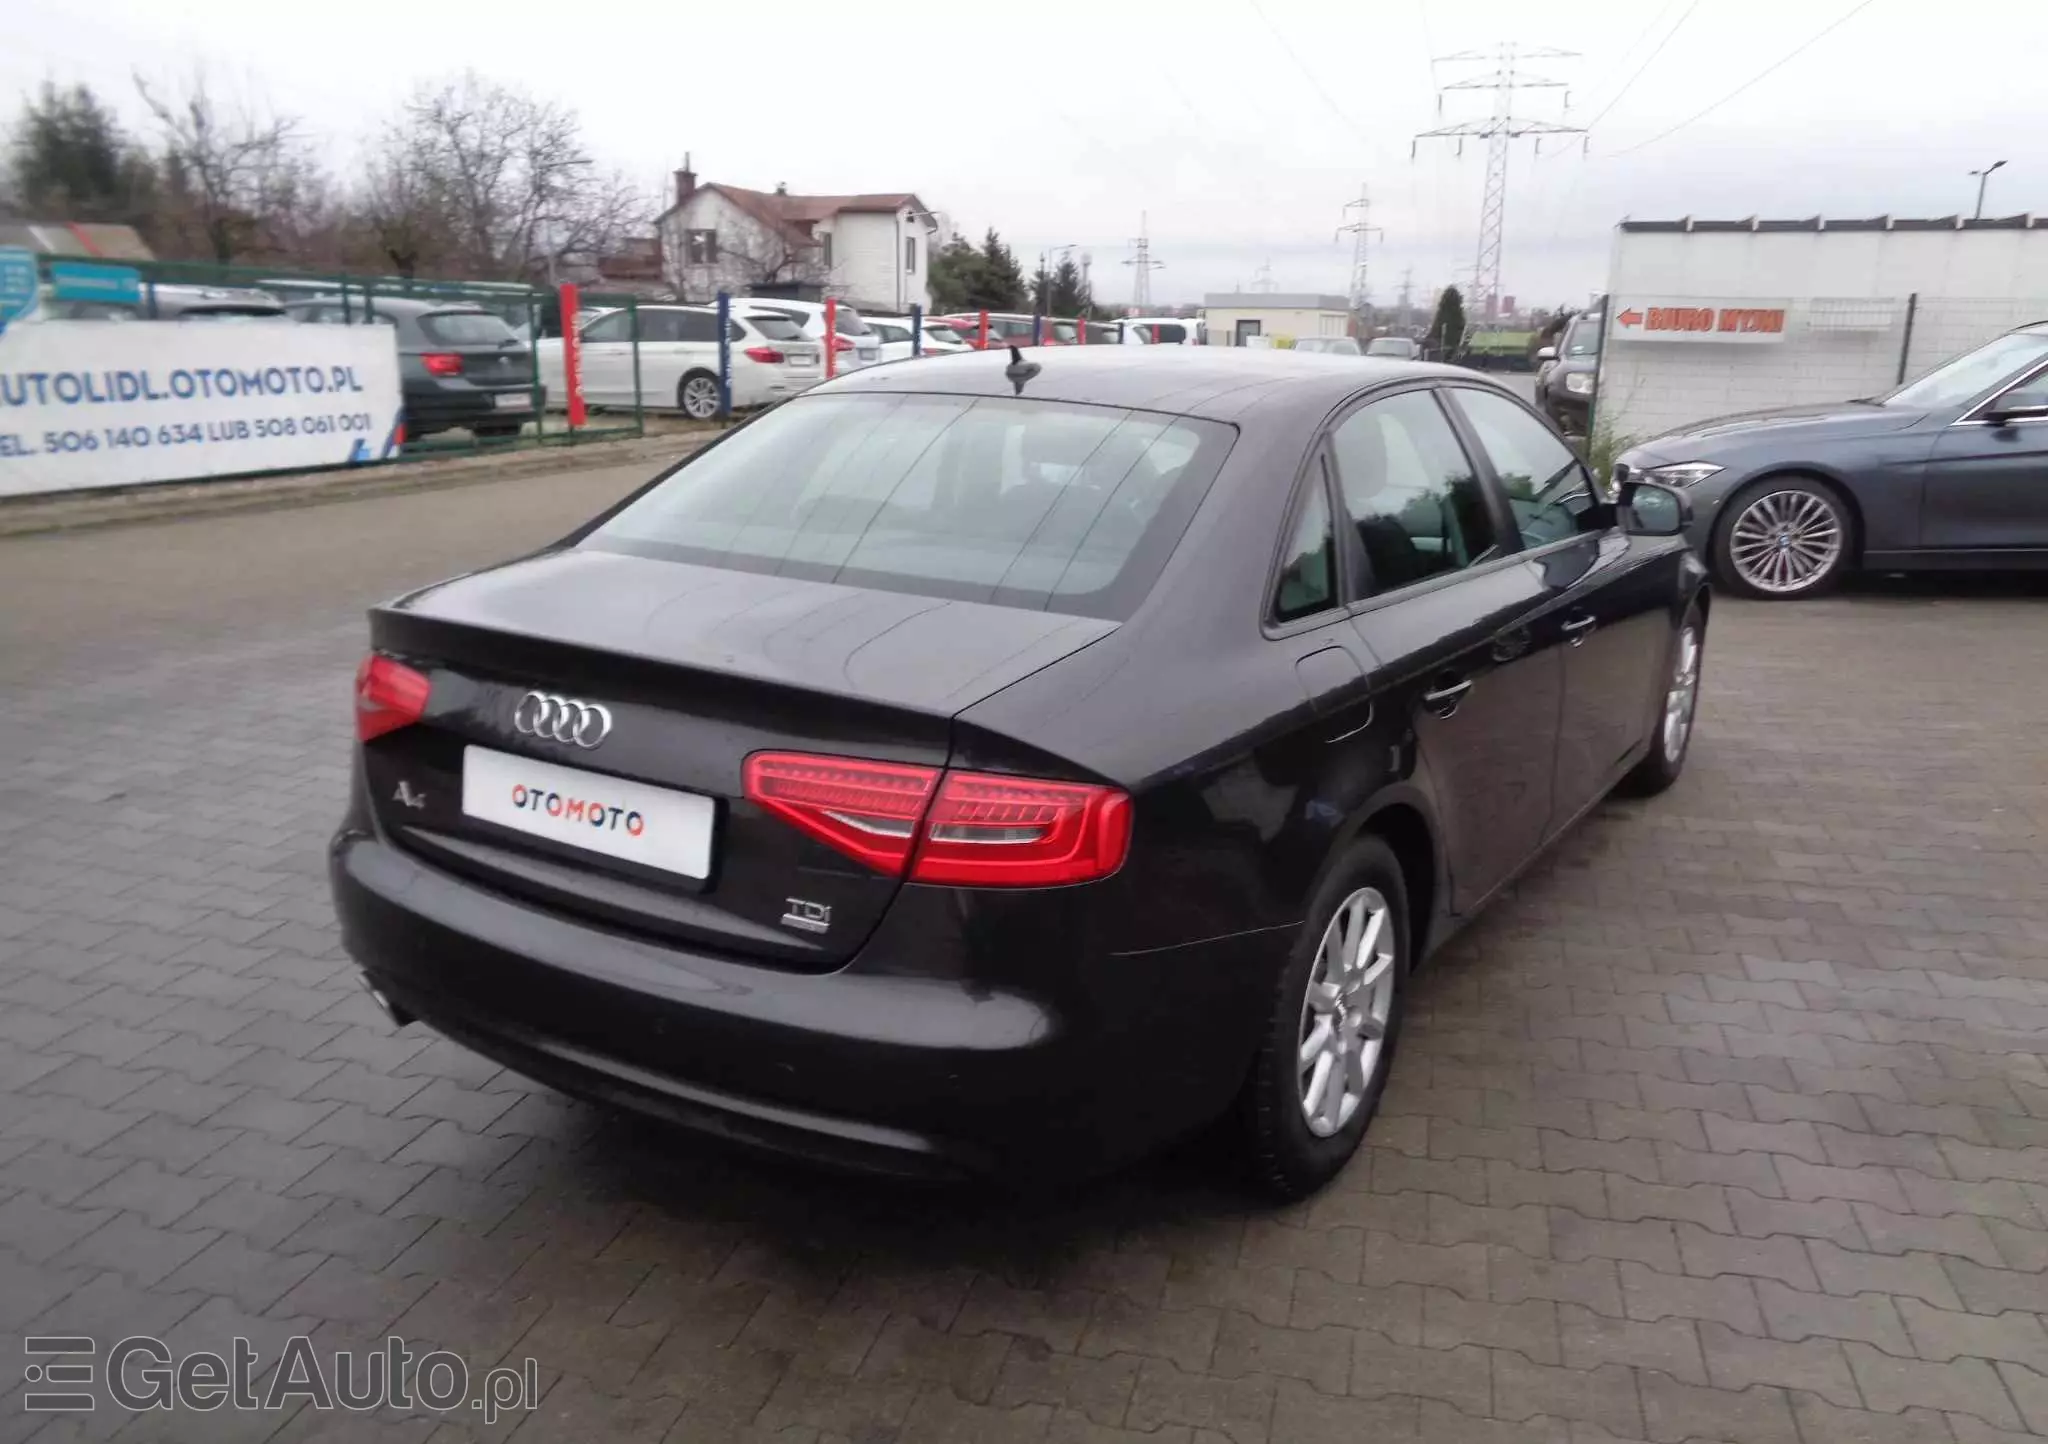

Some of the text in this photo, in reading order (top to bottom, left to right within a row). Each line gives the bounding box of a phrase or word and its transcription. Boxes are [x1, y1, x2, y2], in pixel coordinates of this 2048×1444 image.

[0, 365, 363, 407] UTOLIDL.OTOMOTO.PL
[0, 412, 372, 457] EL. 506 140 634 LUB 508 061 001
[511, 783, 645, 837] OTOMOTO
